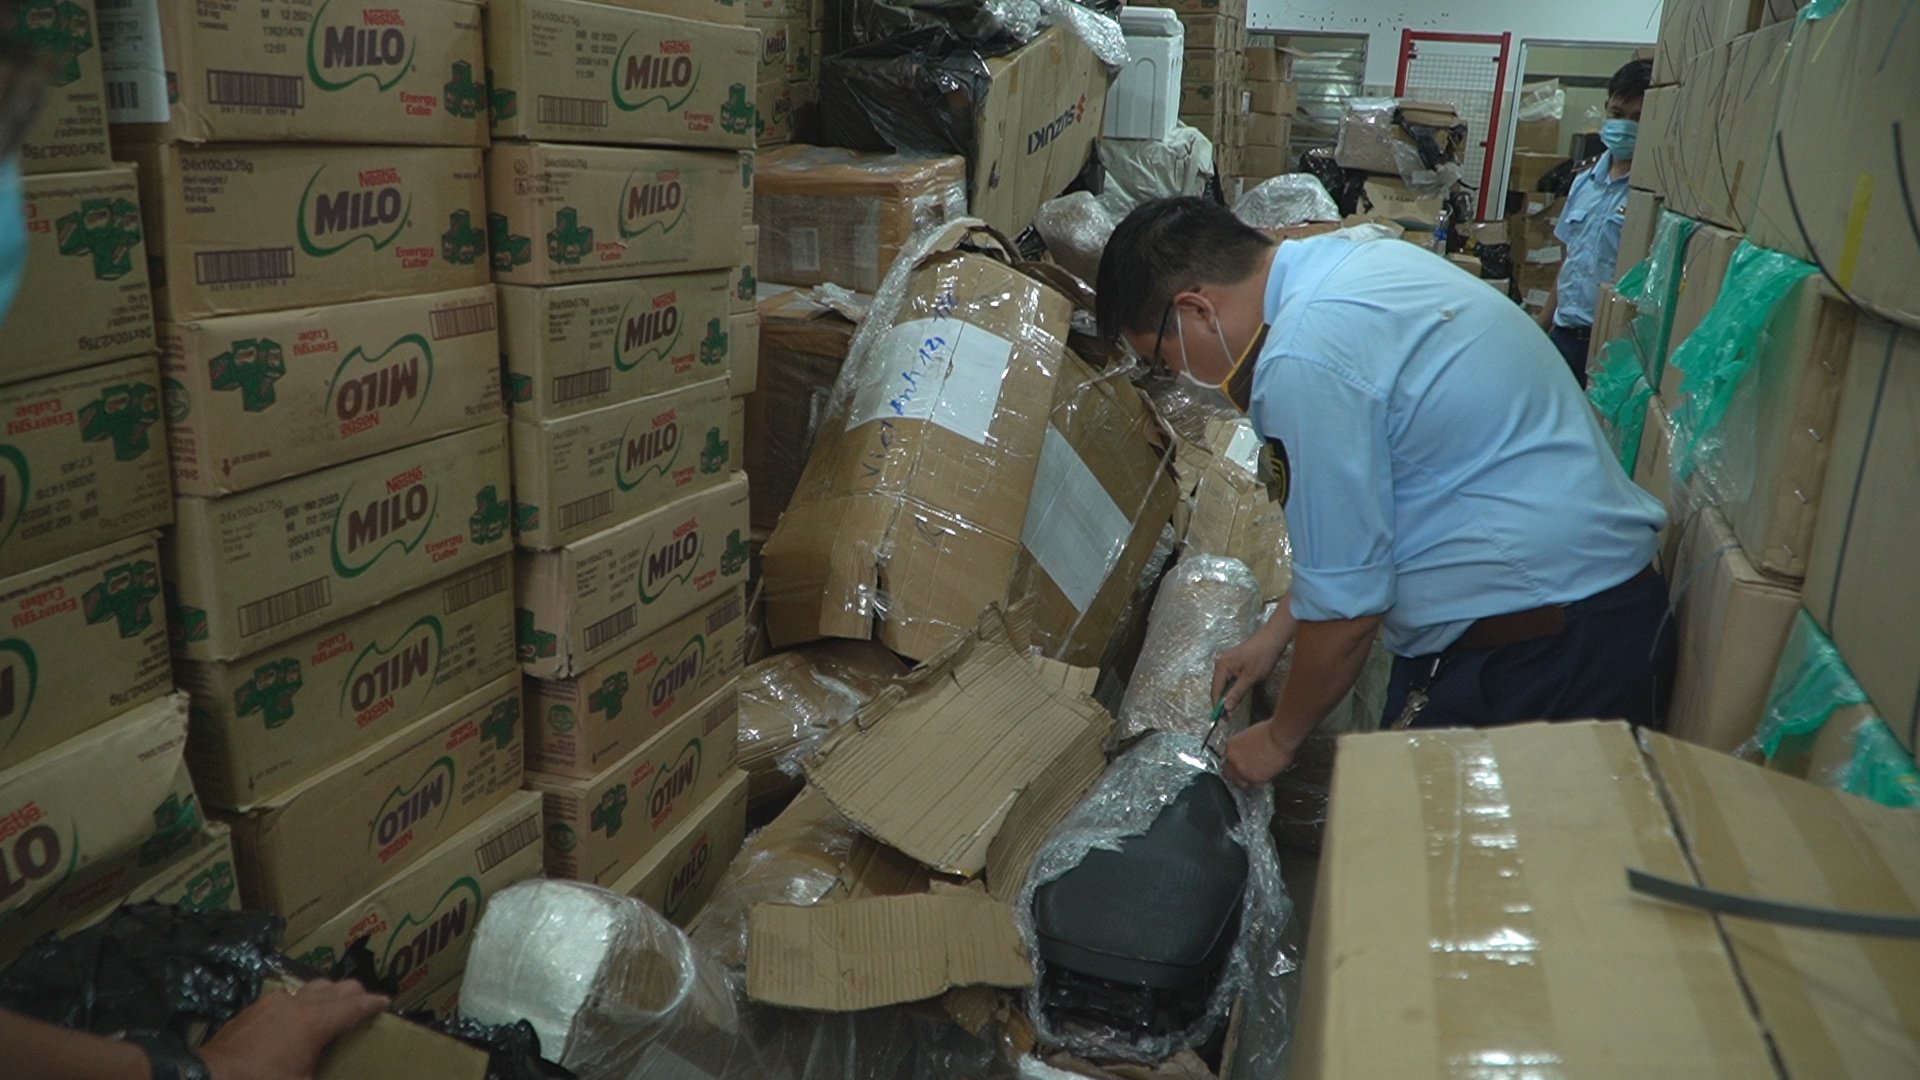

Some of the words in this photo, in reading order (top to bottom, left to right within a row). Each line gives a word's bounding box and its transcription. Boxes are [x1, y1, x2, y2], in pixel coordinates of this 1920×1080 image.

[323, 25, 405, 69] MILO
[624, 54, 692, 91] MILO
[400, 91, 438, 107] Energy
[406, 104, 432, 117] Cube
[684, 110, 714, 124] Energy
[688, 121, 710, 133] Cube
[1026, 103, 1076, 155] SUZUKI
[314, 187, 401, 236] MILO
[627, 180, 682, 221] MILO
[395, 246, 434, 259] Energy
[401, 257, 430, 269] Cube
[298, 328, 329, 342] Cube
[623, 305, 678, 353] MILO
[293, 340, 338, 356] Energy
[336, 356, 418, 420] MILO
[7, 411, 75, 436] Energy
[15, 399, 63, 418] Cube
[625, 422, 678, 473] MILO
[348, 483, 428, 554] MILO
[425, 534, 463, 555] Energy
[432, 547, 459, 563] Cube
[648, 530, 698, 587] MILO
[11, 596, 78, 630] Energy
[20, 586, 65, 610] Cube
[311, 641, 354, 666] Energy
[316, 632, 347, 651] Cube
[351, 636, 429, 713] MILO
[652, 649, 699, 707] MILO
[651, 753, 695, 819] MILO
[377, 773, 444, 847] MILO
[671, 842, 708, 899] MILO
[388, 897, 468, 982] MILO
